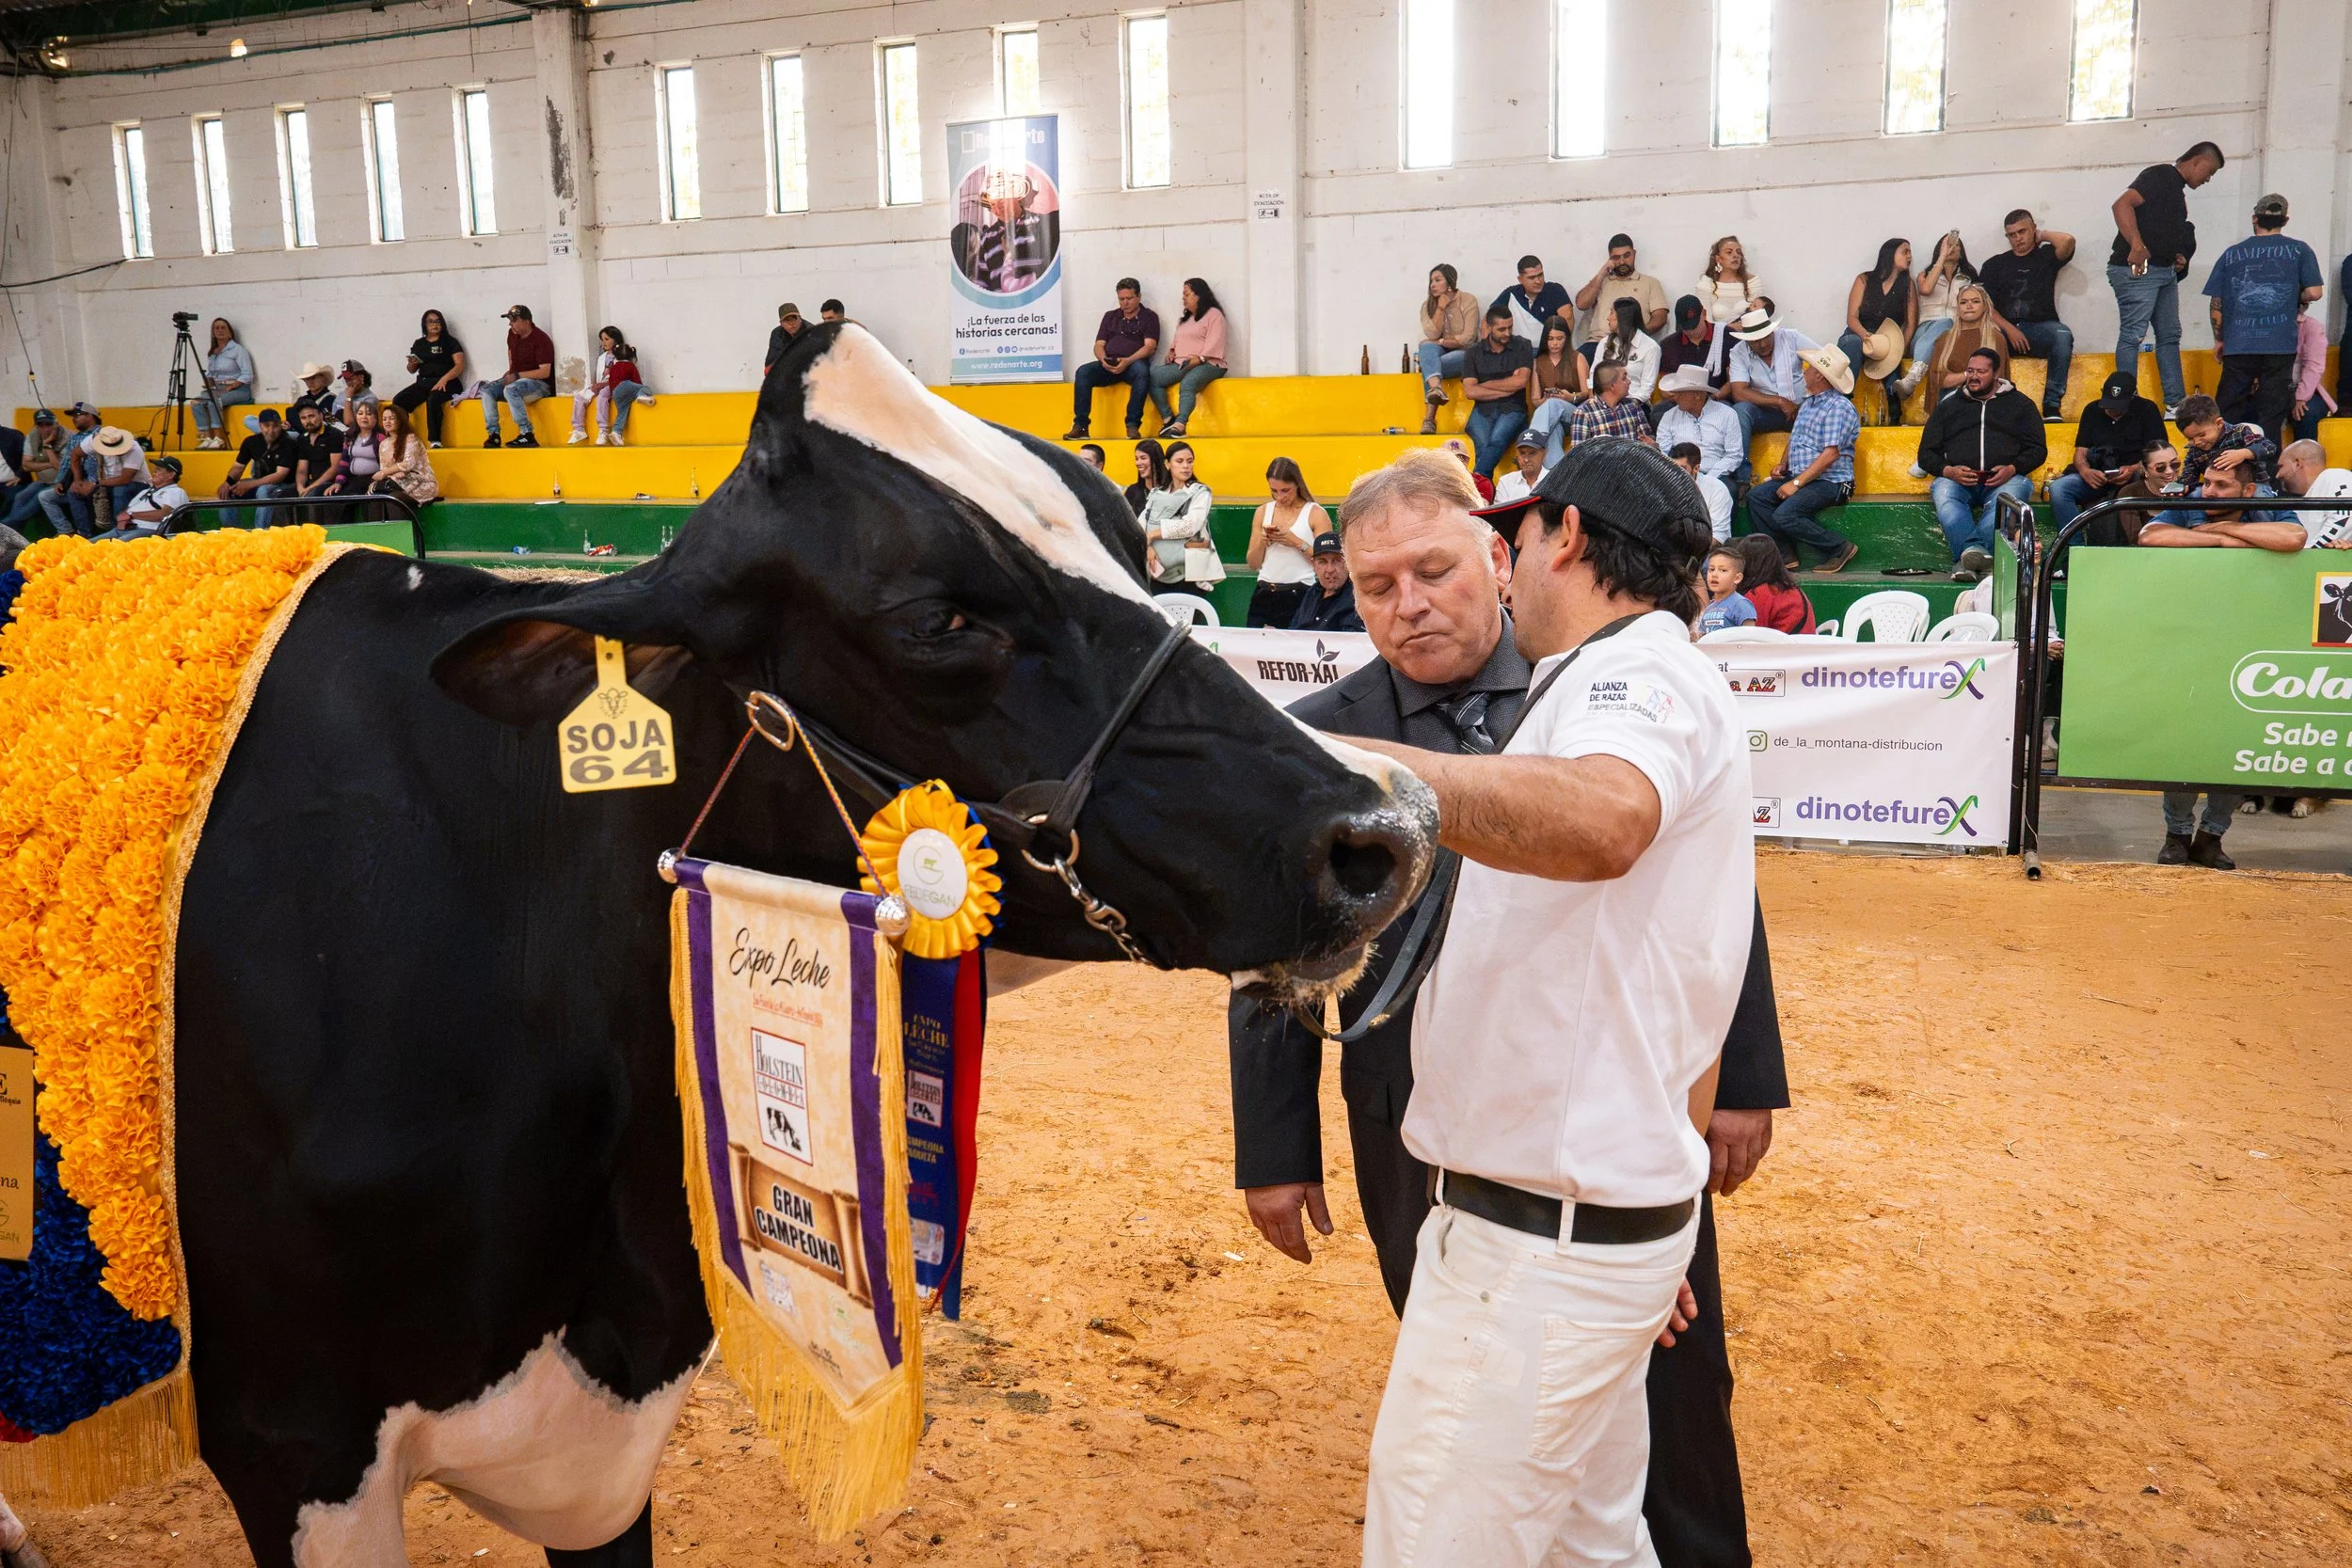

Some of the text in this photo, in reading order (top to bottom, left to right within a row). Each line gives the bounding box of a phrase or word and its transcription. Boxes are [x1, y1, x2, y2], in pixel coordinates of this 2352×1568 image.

[2224, 244, 2301, 266] HAMPTONS
[984, 314, 1015, 325] fuerza
[1017, 313, 1029, 324] de
[1031, 312, 1045, 323] las
[956, 324, 1057, 339] historias cercanas!
[970, 360, 1043, 370] www.redenorte.org
[1590, 682, 1628, 692] ALIANZA
[1746, 676, 1776, 693] AZ
[1587, 704, 1657, 722] ESPECIALIZADAS
[566, 719, 666, 753] SOJA
[1773, 736, 1943, 752] de_la_montana-distribucion
[2263, 721, 2338, 747] Sabe
[569, 750, 670, 784] 64
[2233, 750, 2308, 774] Sabe
[2316, 757, 2336, 775] a
[729, 927, 831, 990] Expo Leche
[755, 1034, 803, 1085] HOLSTEIN
[772, 1185, 814, 1228] GRAN
[755, 1208, 842, 1271] CAMPEONA
